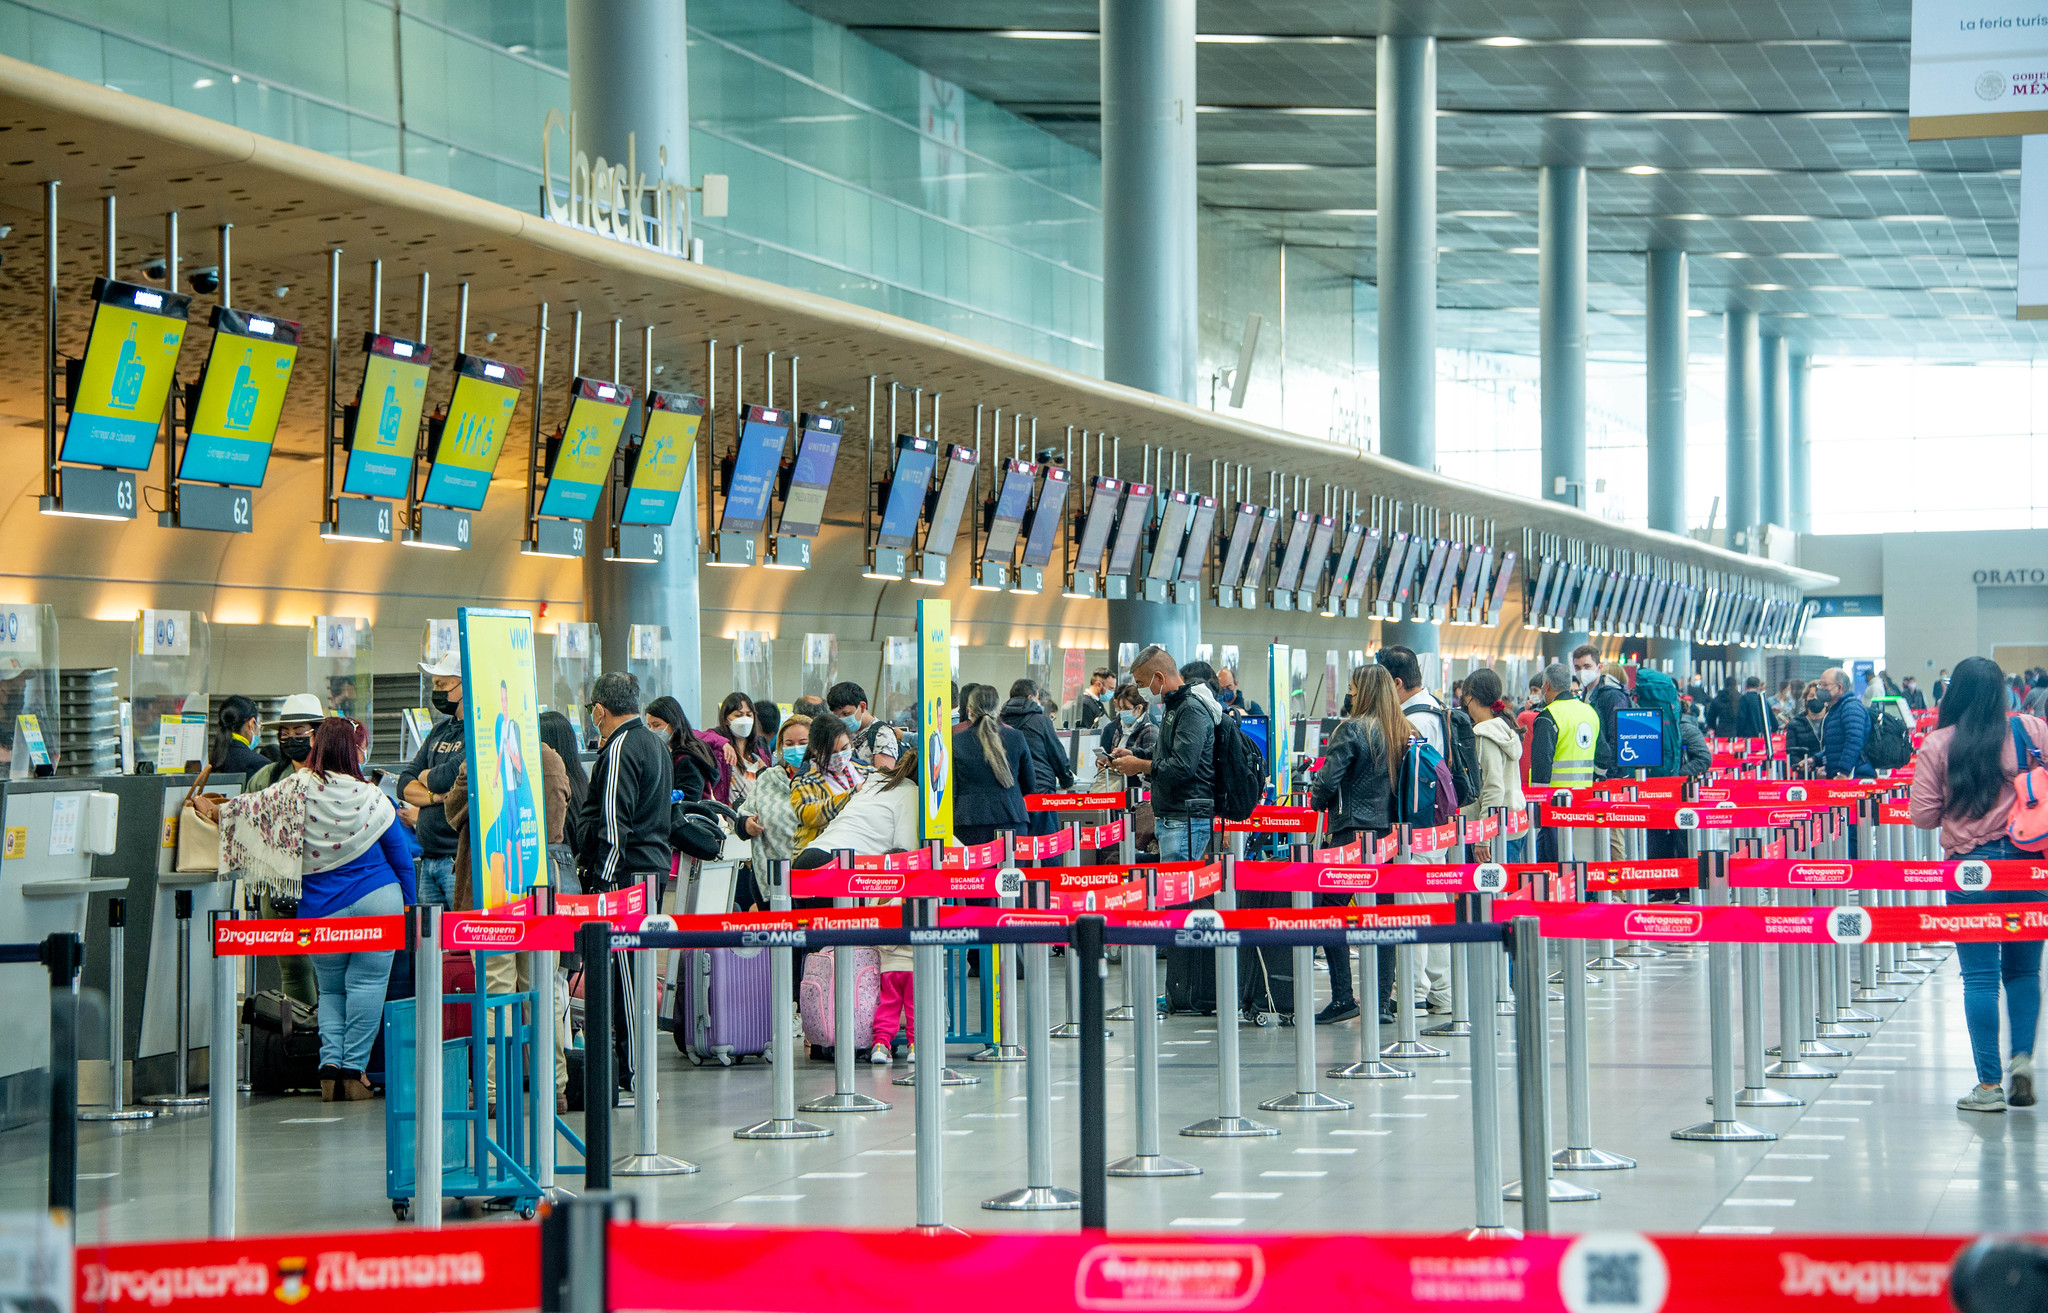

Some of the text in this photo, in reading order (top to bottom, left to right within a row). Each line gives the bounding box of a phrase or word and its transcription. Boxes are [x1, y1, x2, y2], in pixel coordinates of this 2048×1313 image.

[1960, 20, 1975, 31] La
[1980, 16, 2011, 29] feria
[2012, 71, 2048, 81] GOBIE
[808, 442, 831, 453] UNITED
[901, 469, 922, 484] UNITED
[117, 481, 133, 510] 63
[233, 497, 248, 524] 62
[378, 509, 390, 534] 61
[457, 518, 469, 543] 60
[572, 528, 583, 550] 59
[653, 533, 663, 555] 58
[746, 540, 754, 560] 57
[802, 543, 810, 564] 56
[509, 628, 530, 651] VIVA
[931, 629, 944, 643] VIVA
[1042, 797, 1116, 807] Droguería Alemana
[1638, 791, 1672, 799] Alemana
[1828, 790, 1865, 799] Droguería
[1262, 817, 1300, 826] Alemana
[1551, 811, 1646, 822] Droguería Alemana
[1060, 872, 1118, 887] Droguería
[1621, 867, 1679, 880] Alemana
[813, 914, 880, 929] Alemana
[1362, 914, 1431, 927] Alemana
[1919, 913, 2002, 933] Droguería
[219, 927, 382, 945] Droguería Alemana
[910, 927, 979, 942] MIGRACIÓN
[1346, 928, 1417, 942] MIGRACIÓN
[1644, 924, 1691, 933] virtual.com
[1766, 925, 1813, 933] DESCUBRE
[82, 1251, 484, 1305] Droguería Alemana
[1780, 1252, 1950, 1304] Droguer
